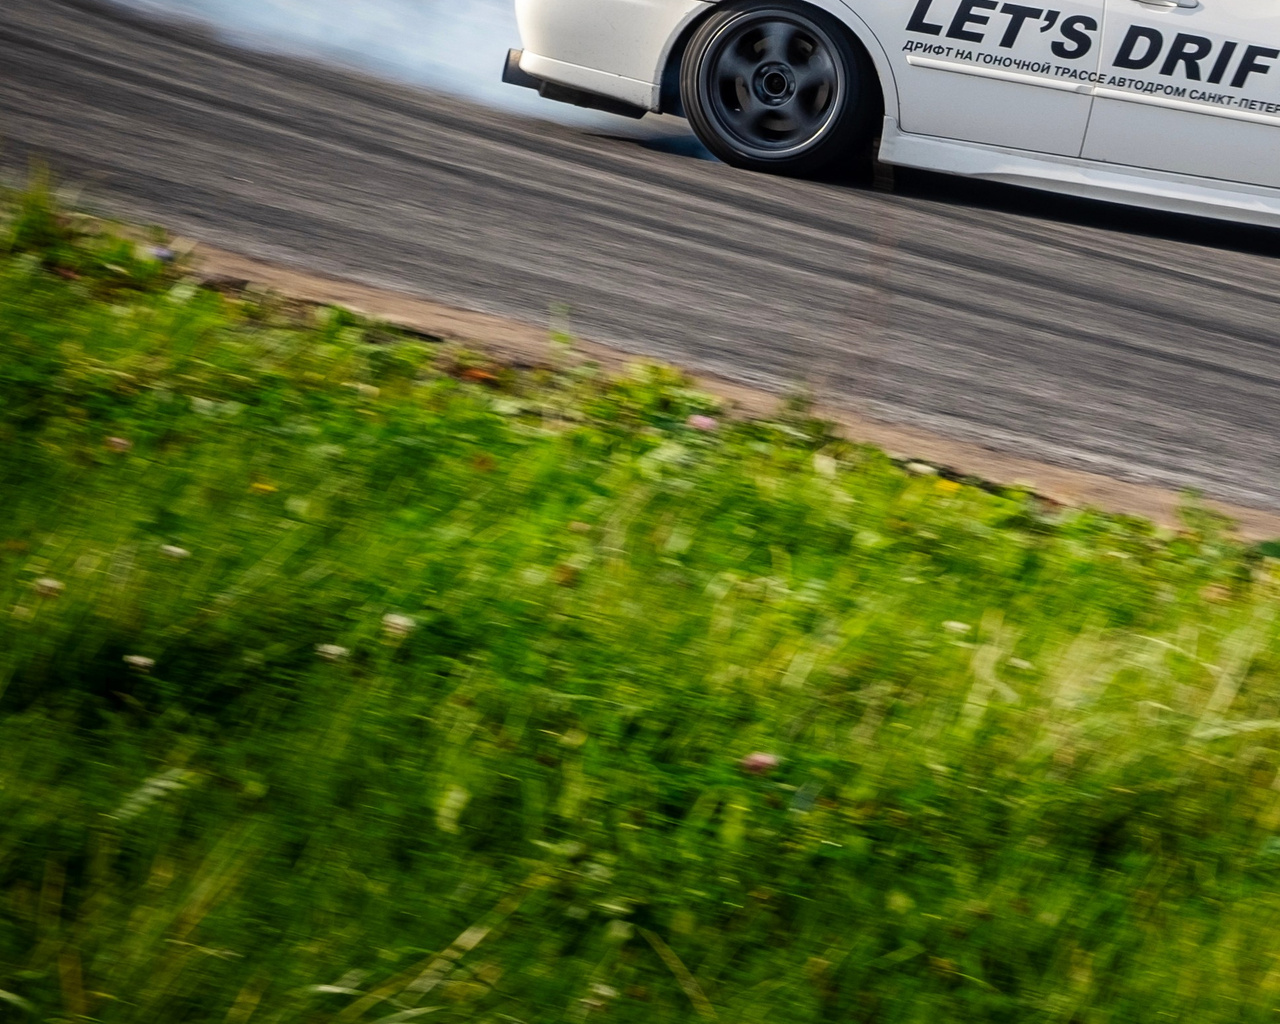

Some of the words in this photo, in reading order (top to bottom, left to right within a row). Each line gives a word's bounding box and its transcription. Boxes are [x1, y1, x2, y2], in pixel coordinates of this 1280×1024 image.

[902, 40, 953, 57] ДРИФТ
[955, 49, 973, 61] НА
[975, 52, 1051, 74] ГОНОЧНОЙ
[1054, 65, 1107, 84] ТРАССЕ
[1107, 74, 1188, 97] АВТОДРОМ
